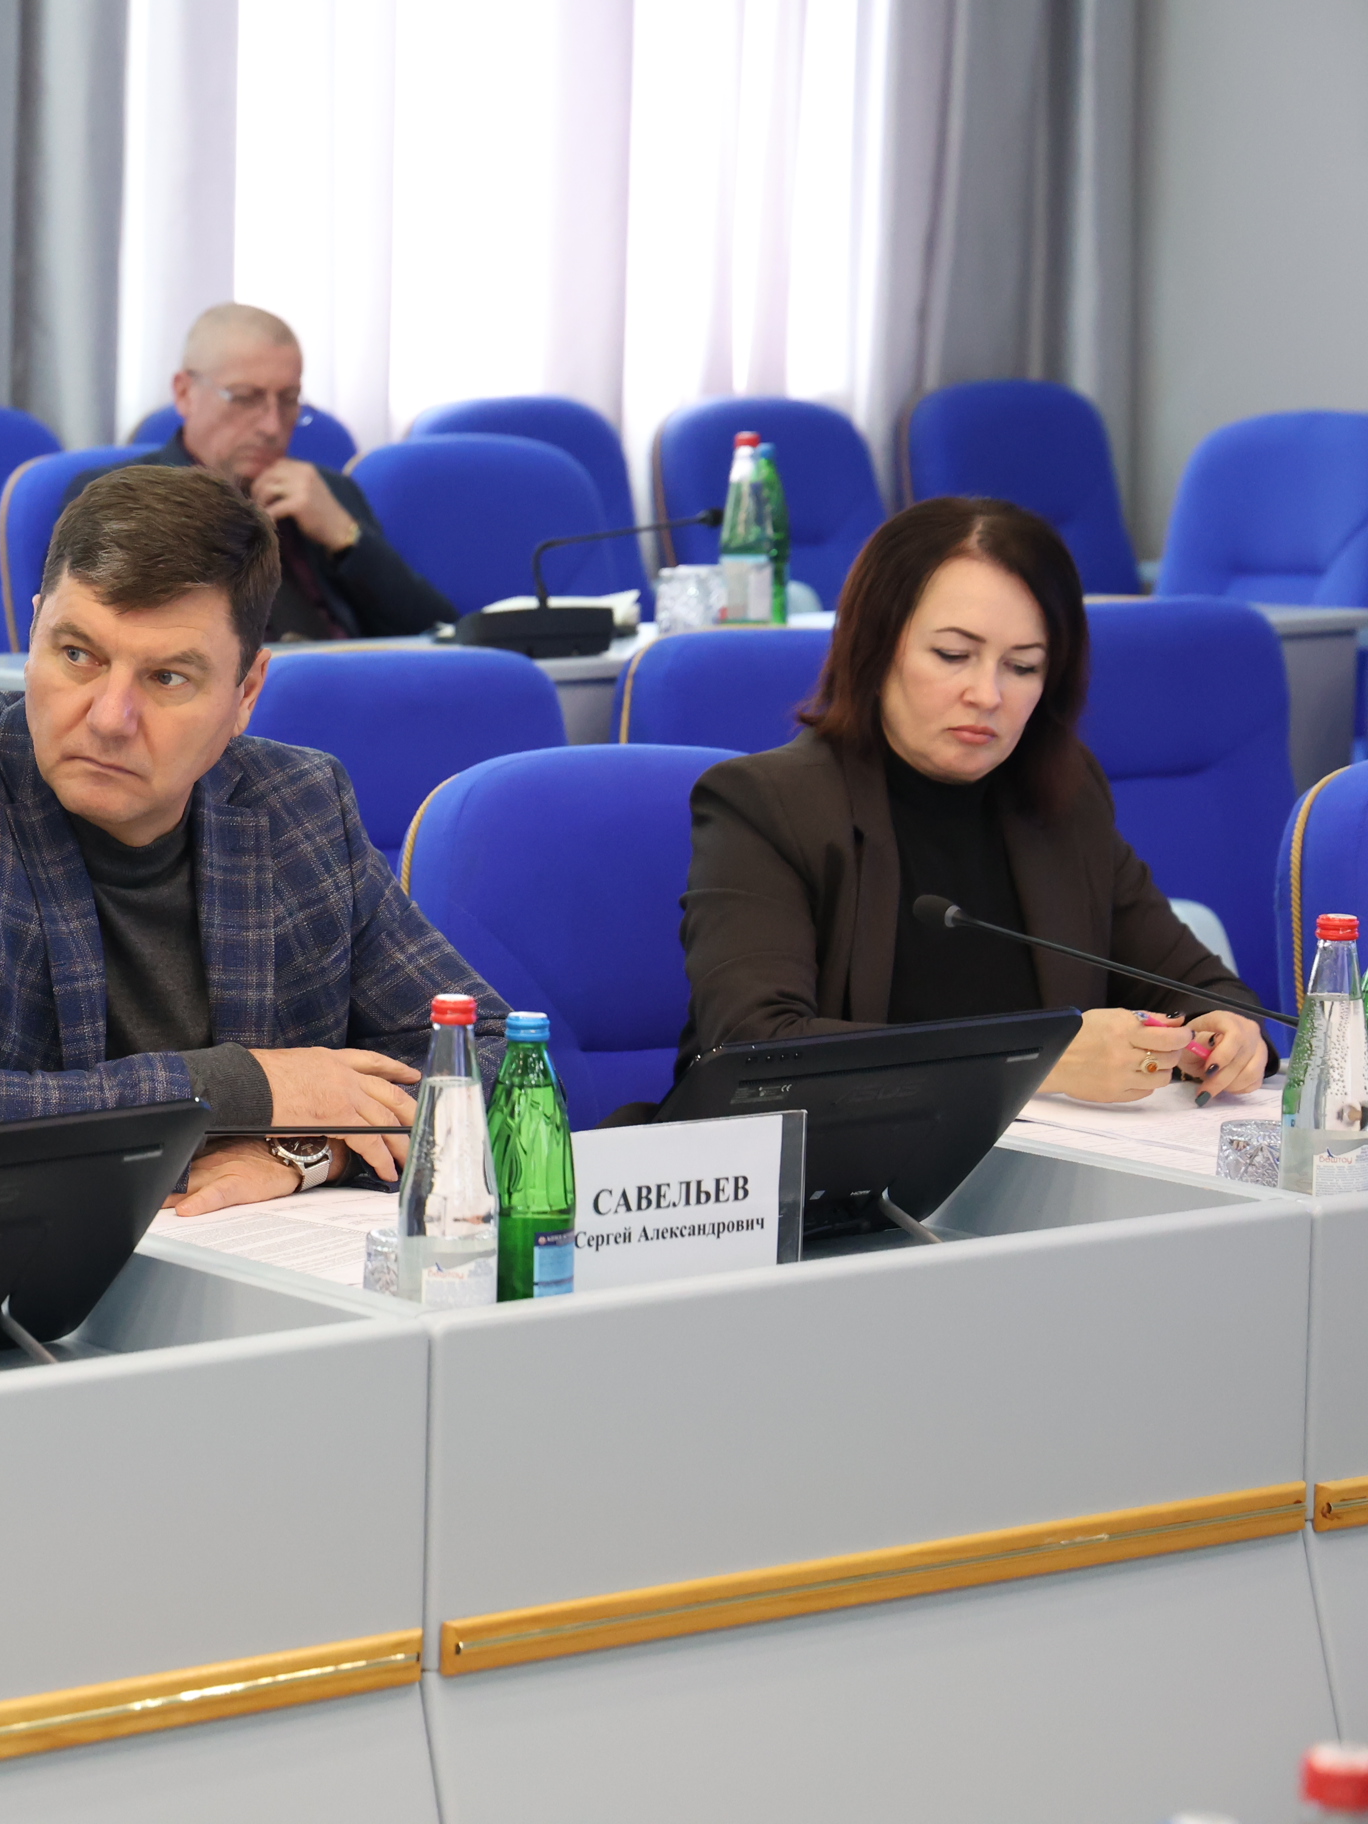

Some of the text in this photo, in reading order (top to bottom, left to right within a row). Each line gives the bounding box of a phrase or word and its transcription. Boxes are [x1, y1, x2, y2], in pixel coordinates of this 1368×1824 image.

[592, 1175, 750, 1217] САВЕЛЬЕВ
[574, 1226, 632, 1252] Сергей
[637, 1216, 765, 1243] Александрович
